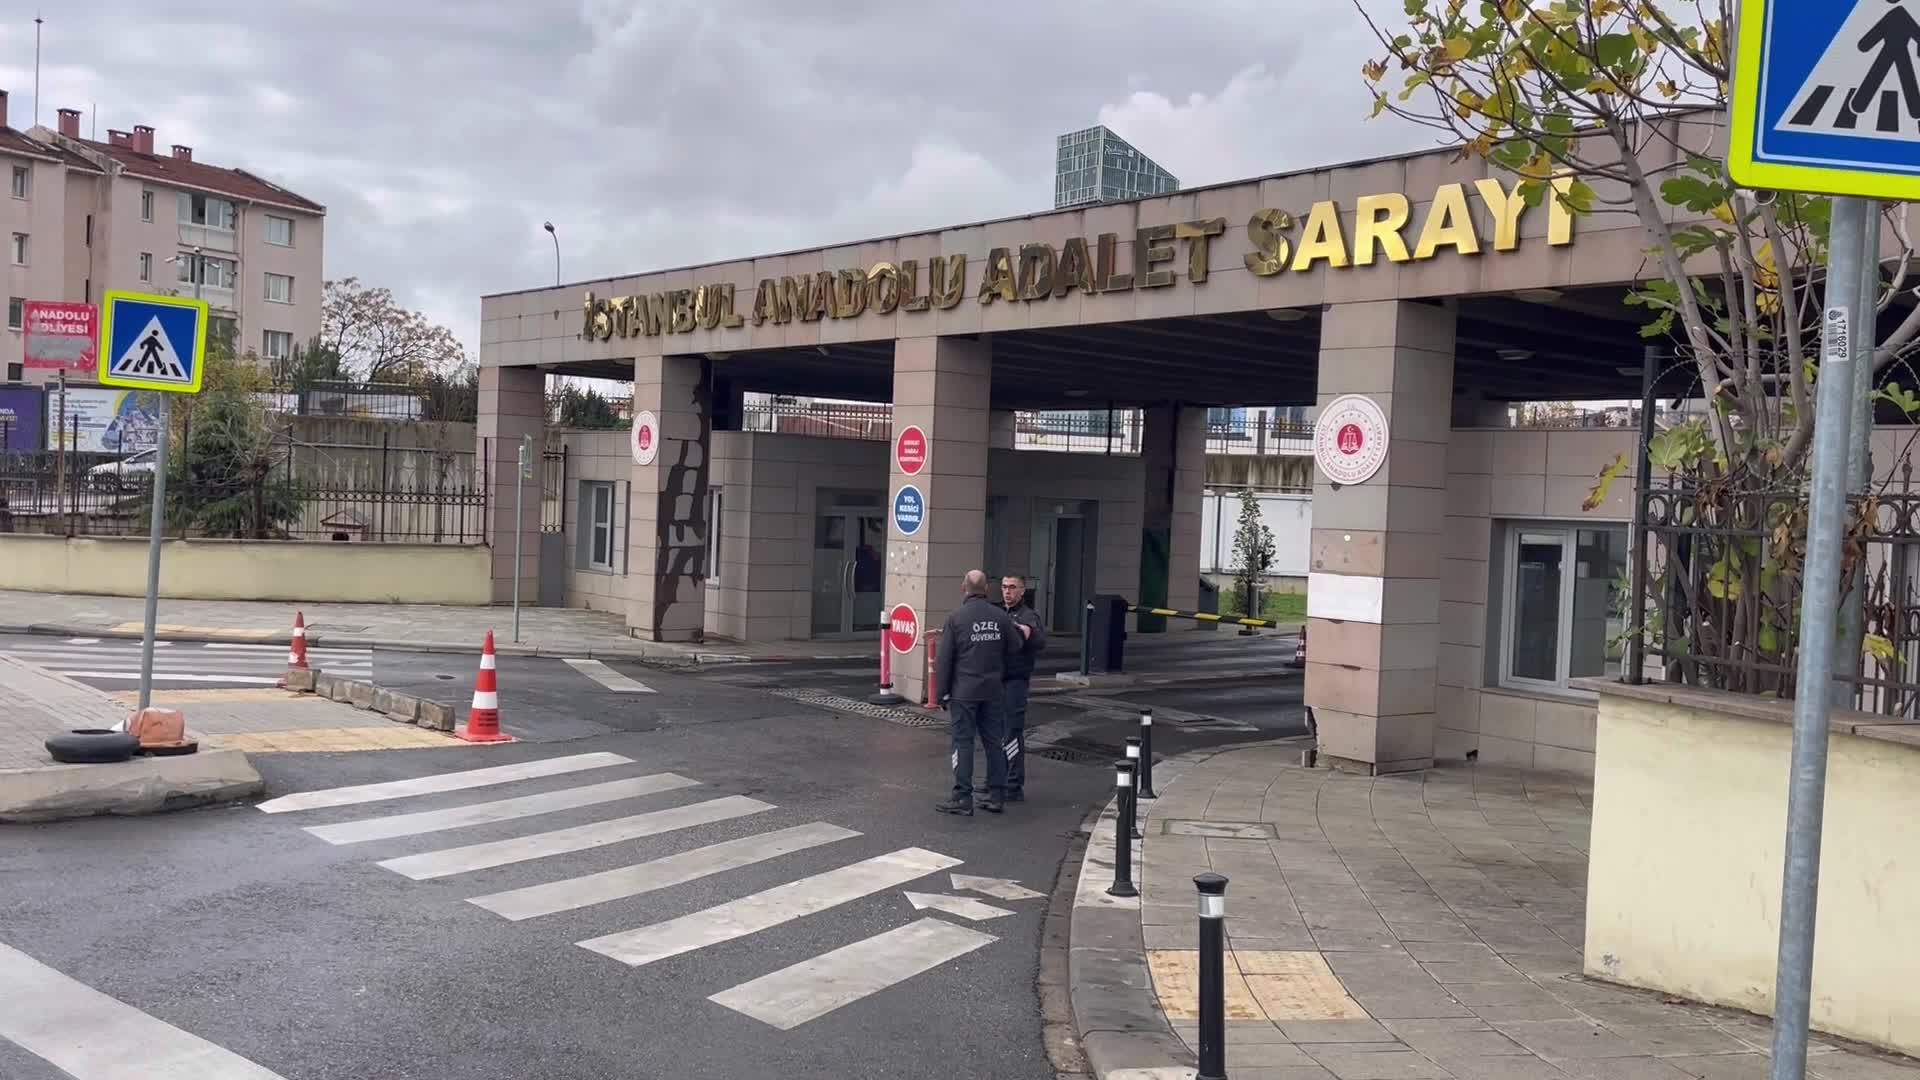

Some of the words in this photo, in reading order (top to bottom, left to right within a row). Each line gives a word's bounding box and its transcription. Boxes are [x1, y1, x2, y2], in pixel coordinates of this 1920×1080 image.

[582, 289, 744, 342] İSTANBUL
[752, 253, 966, 327] ANADOLU
[977, 217, 1227, 304] ADALET
[1244, 167, 1575, 277] SARAYI
[32, 309, 90, 321] ANADOLU
[32, 321, 89, 334] DLİYESİ
[1838, 319, 1847, 358] 1716029
[904, 495, 915, 503] YOL
[892, 619, 915, 638] YAVAŞ
[972, 620, 1000, 633] ÖZEL
[970, 632, 1001, 642] GÜVENLİK
